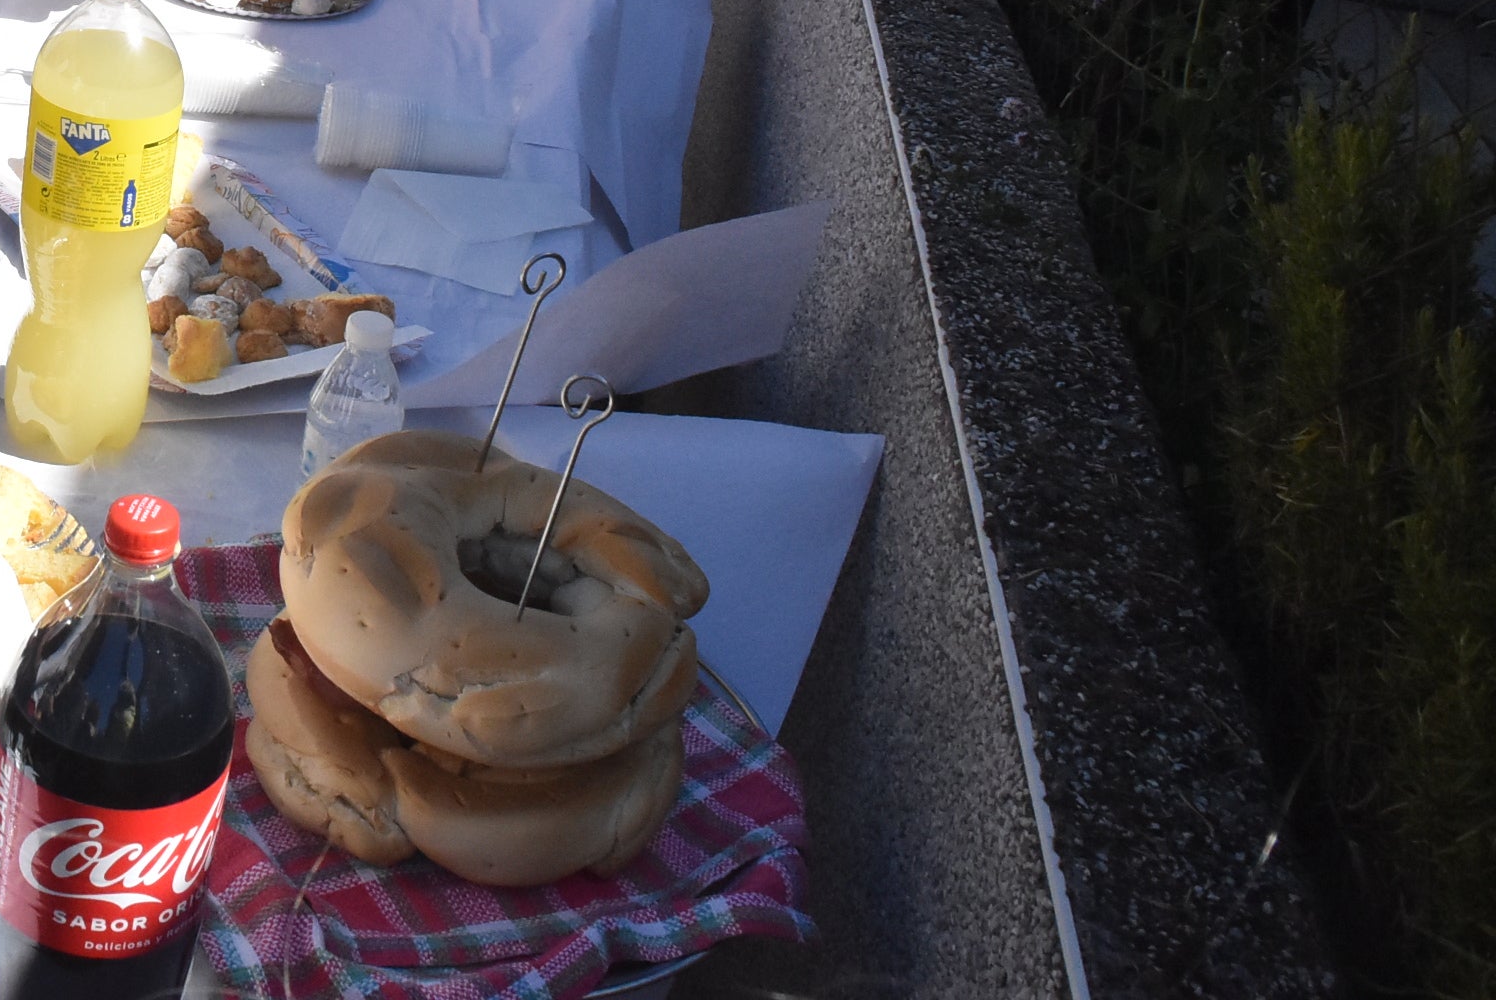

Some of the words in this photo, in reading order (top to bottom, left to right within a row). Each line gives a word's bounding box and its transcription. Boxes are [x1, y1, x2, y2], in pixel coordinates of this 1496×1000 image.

[61, 117, 110, 141] FANTA
[93, 150, 100, 161] 2
[122, 214, 132, 224] 8
[52, 909, 148, 932] SABOR
[84, 937, 151, 951] Deliciosa
